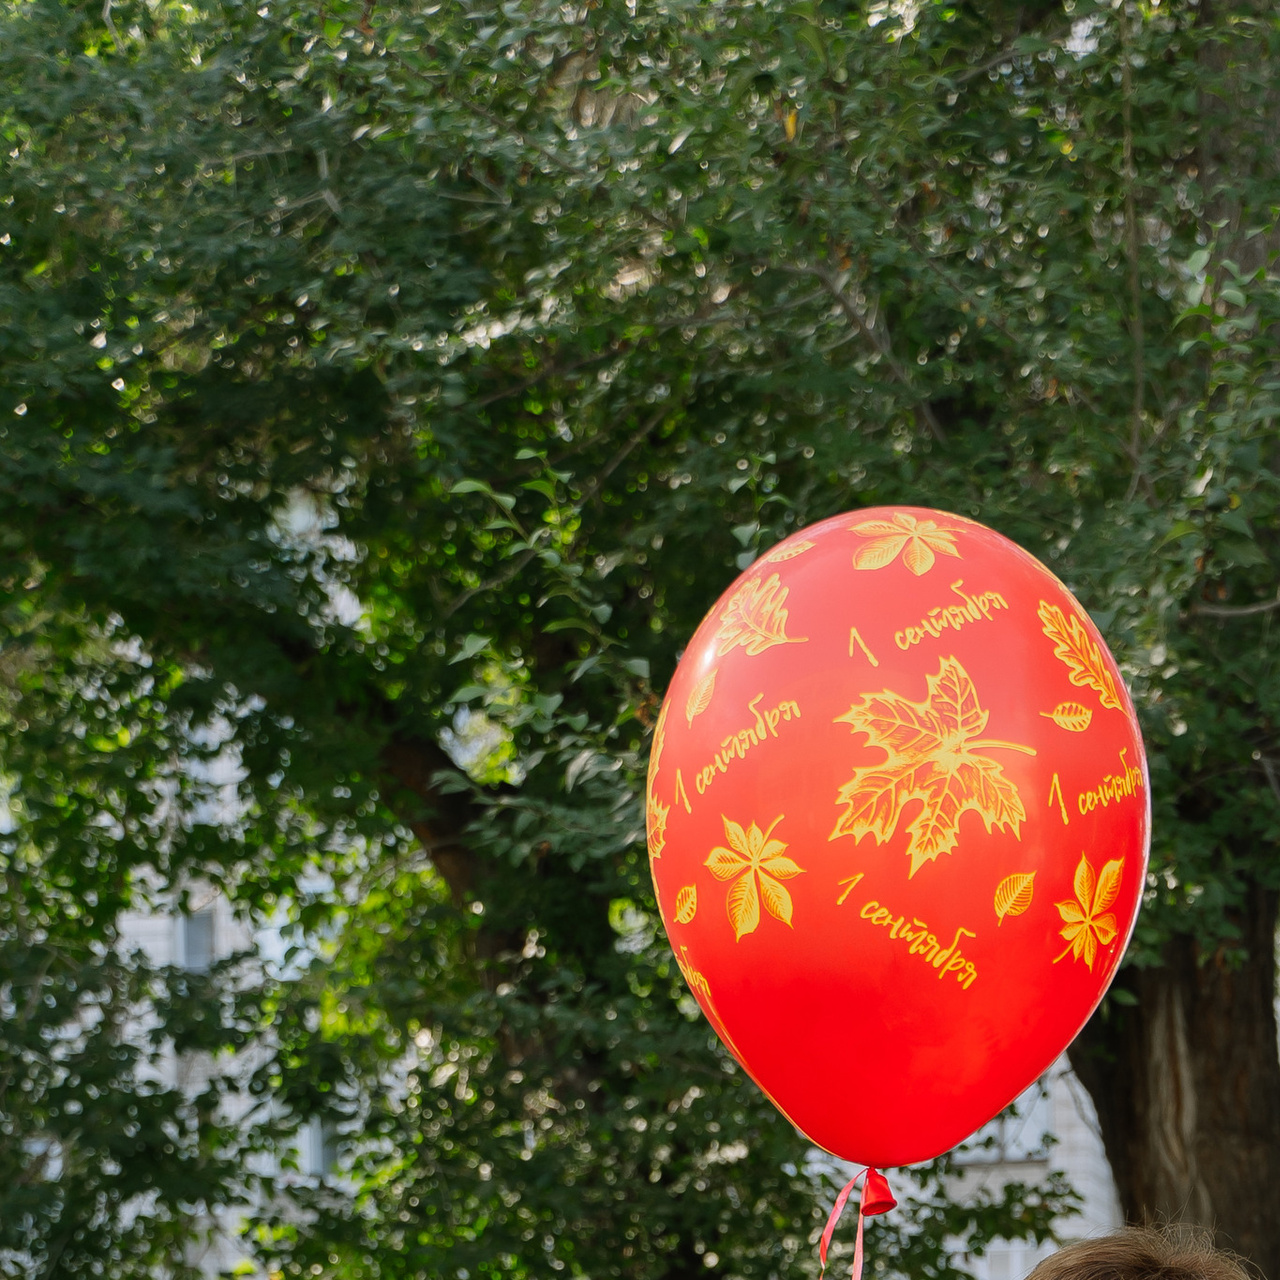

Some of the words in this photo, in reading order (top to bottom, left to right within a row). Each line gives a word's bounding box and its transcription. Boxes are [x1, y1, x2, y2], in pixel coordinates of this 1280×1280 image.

[849, 626, 879, 667] 1
[894, 578, 1009, 651] сентября
[675, 768, 692, 814] 1
[695, 692, 801, 795] сентября
[1048, 773, 1069, 826] 1
[836, 872, 864, 905] 1
[860, 900, 977, 990] сентября
